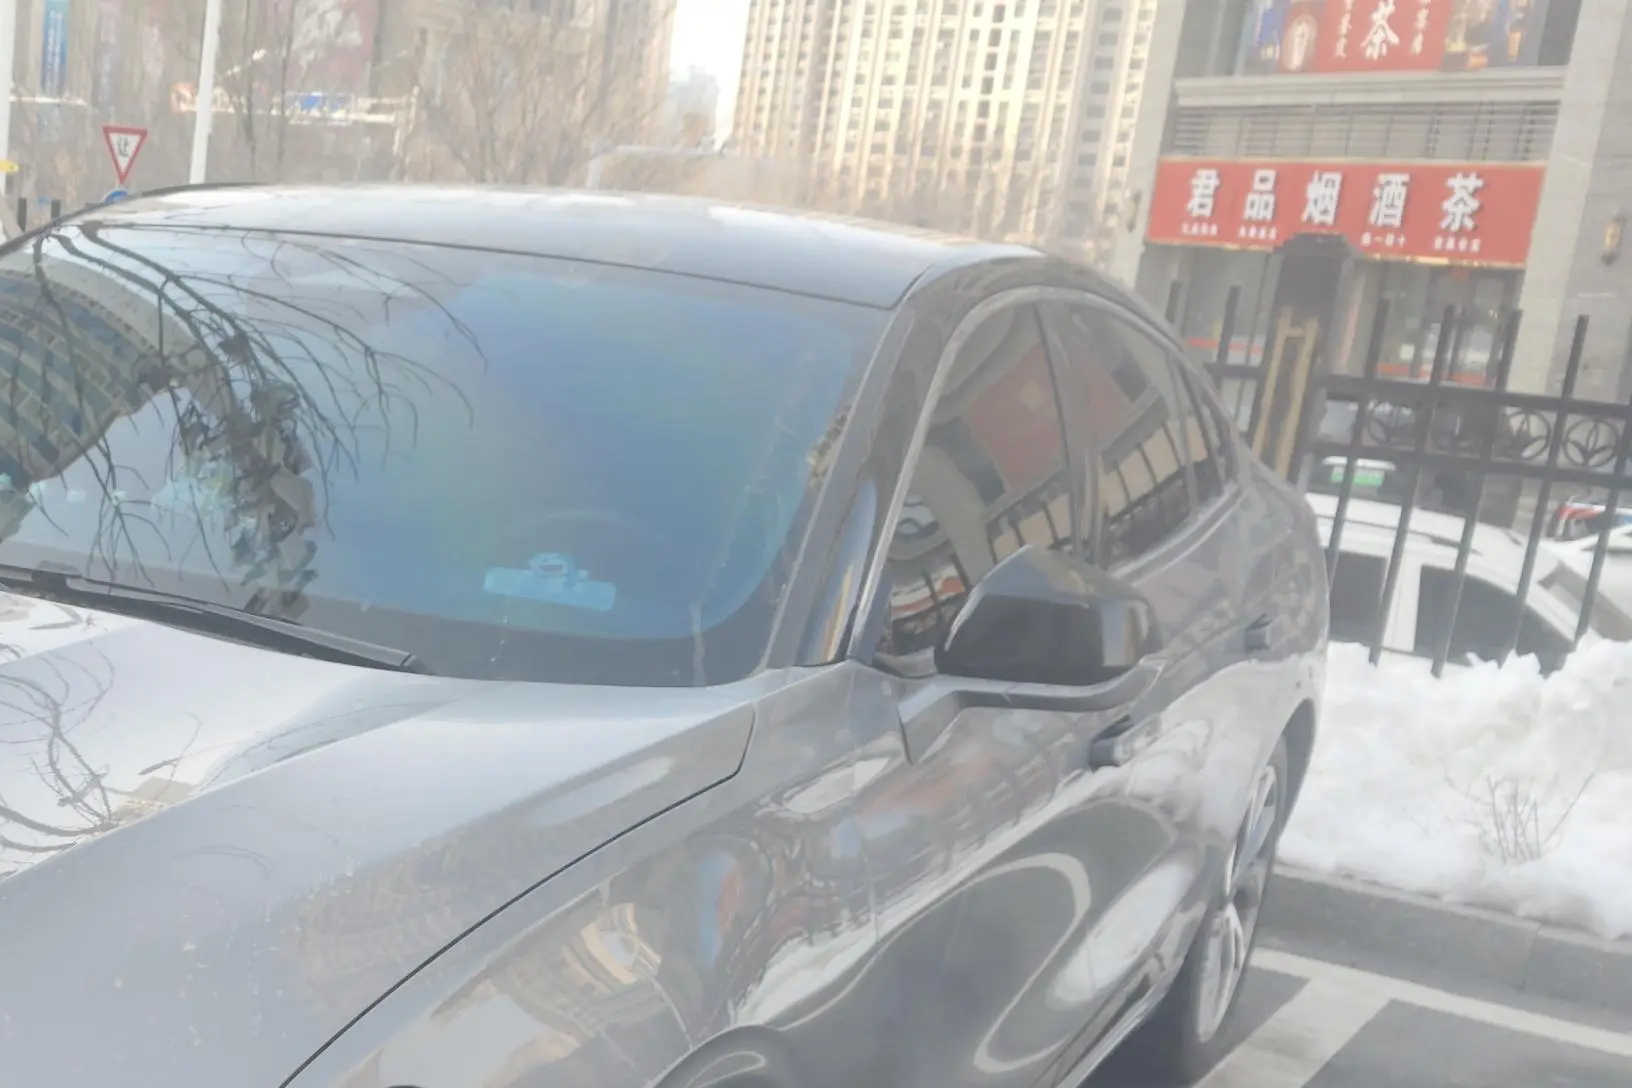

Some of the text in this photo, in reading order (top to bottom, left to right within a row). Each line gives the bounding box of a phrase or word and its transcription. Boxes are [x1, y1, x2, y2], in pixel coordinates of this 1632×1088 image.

[1186, 168, 1485, 232] 君品烟酒茶
